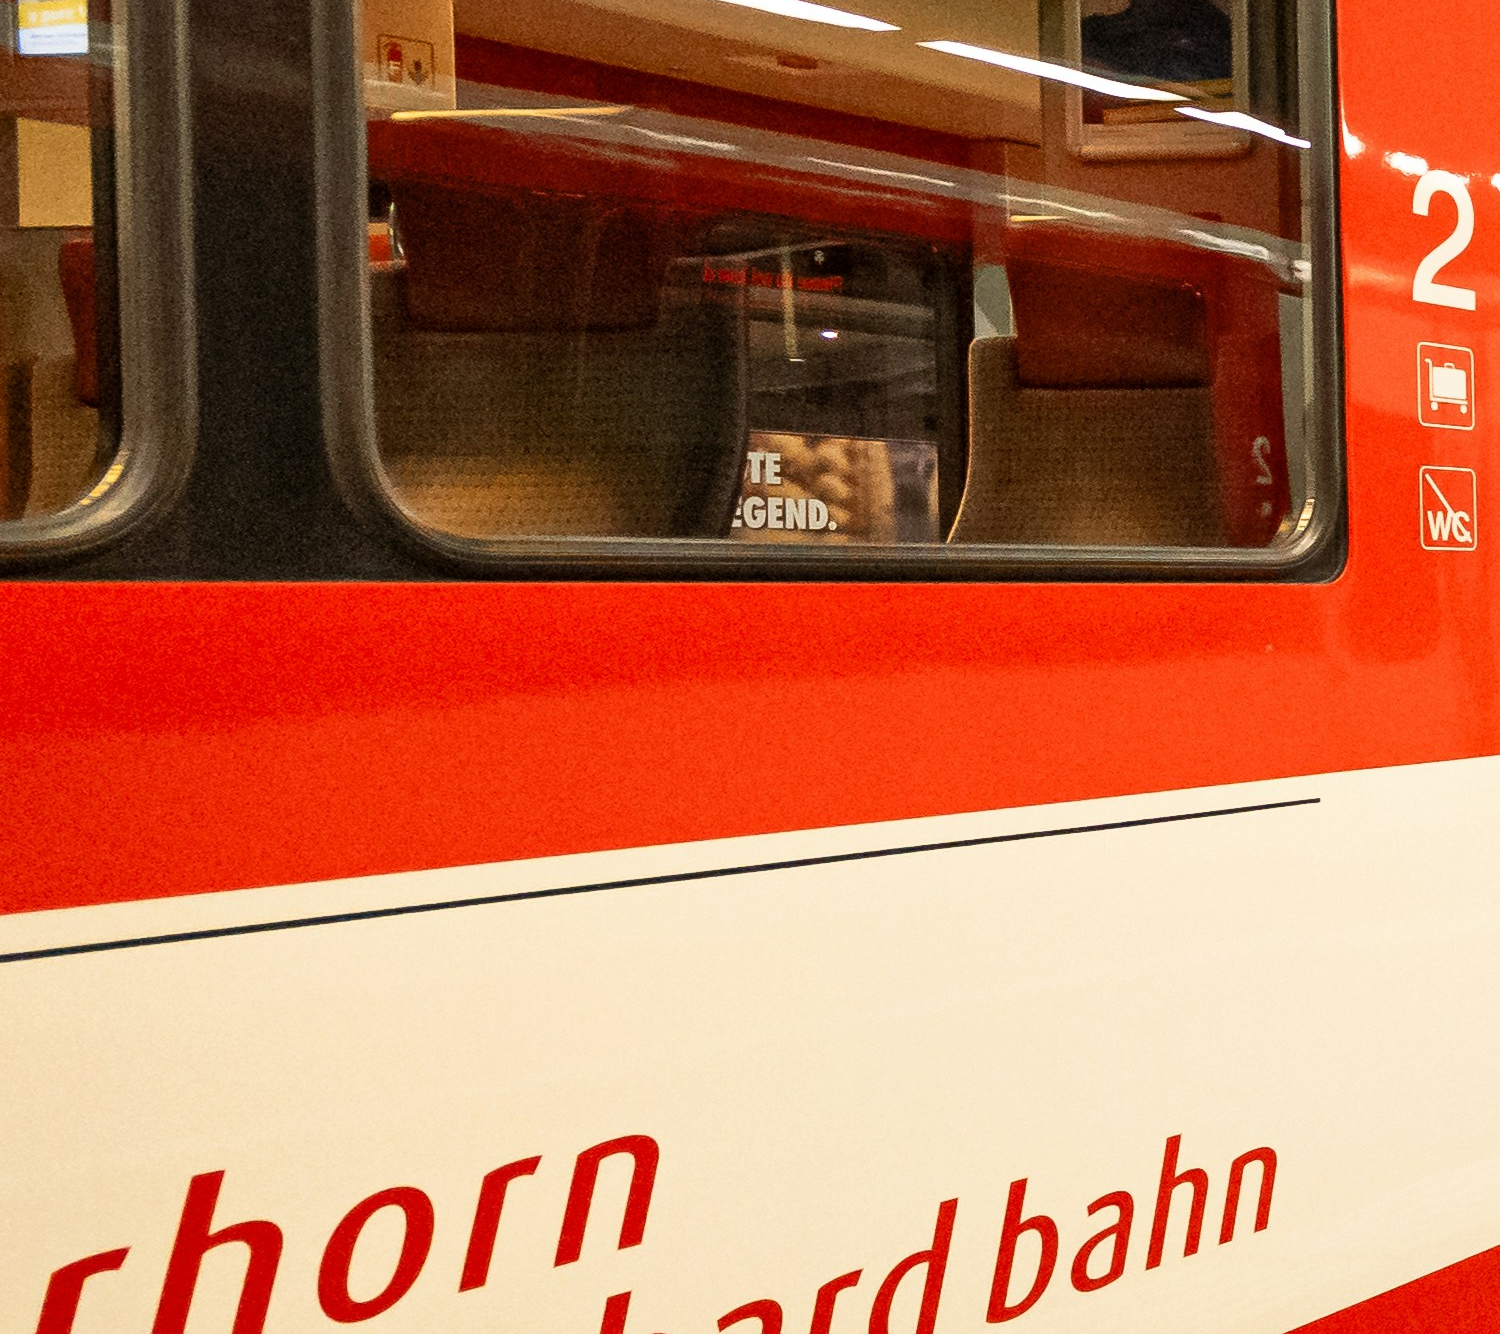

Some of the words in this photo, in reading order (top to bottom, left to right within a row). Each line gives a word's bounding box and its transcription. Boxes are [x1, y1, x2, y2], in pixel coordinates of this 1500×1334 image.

[1412, 170, 1476, 311] 2
[747, 452, 781, 485] TE
[987, 1135, 1277, 1323] bahn
